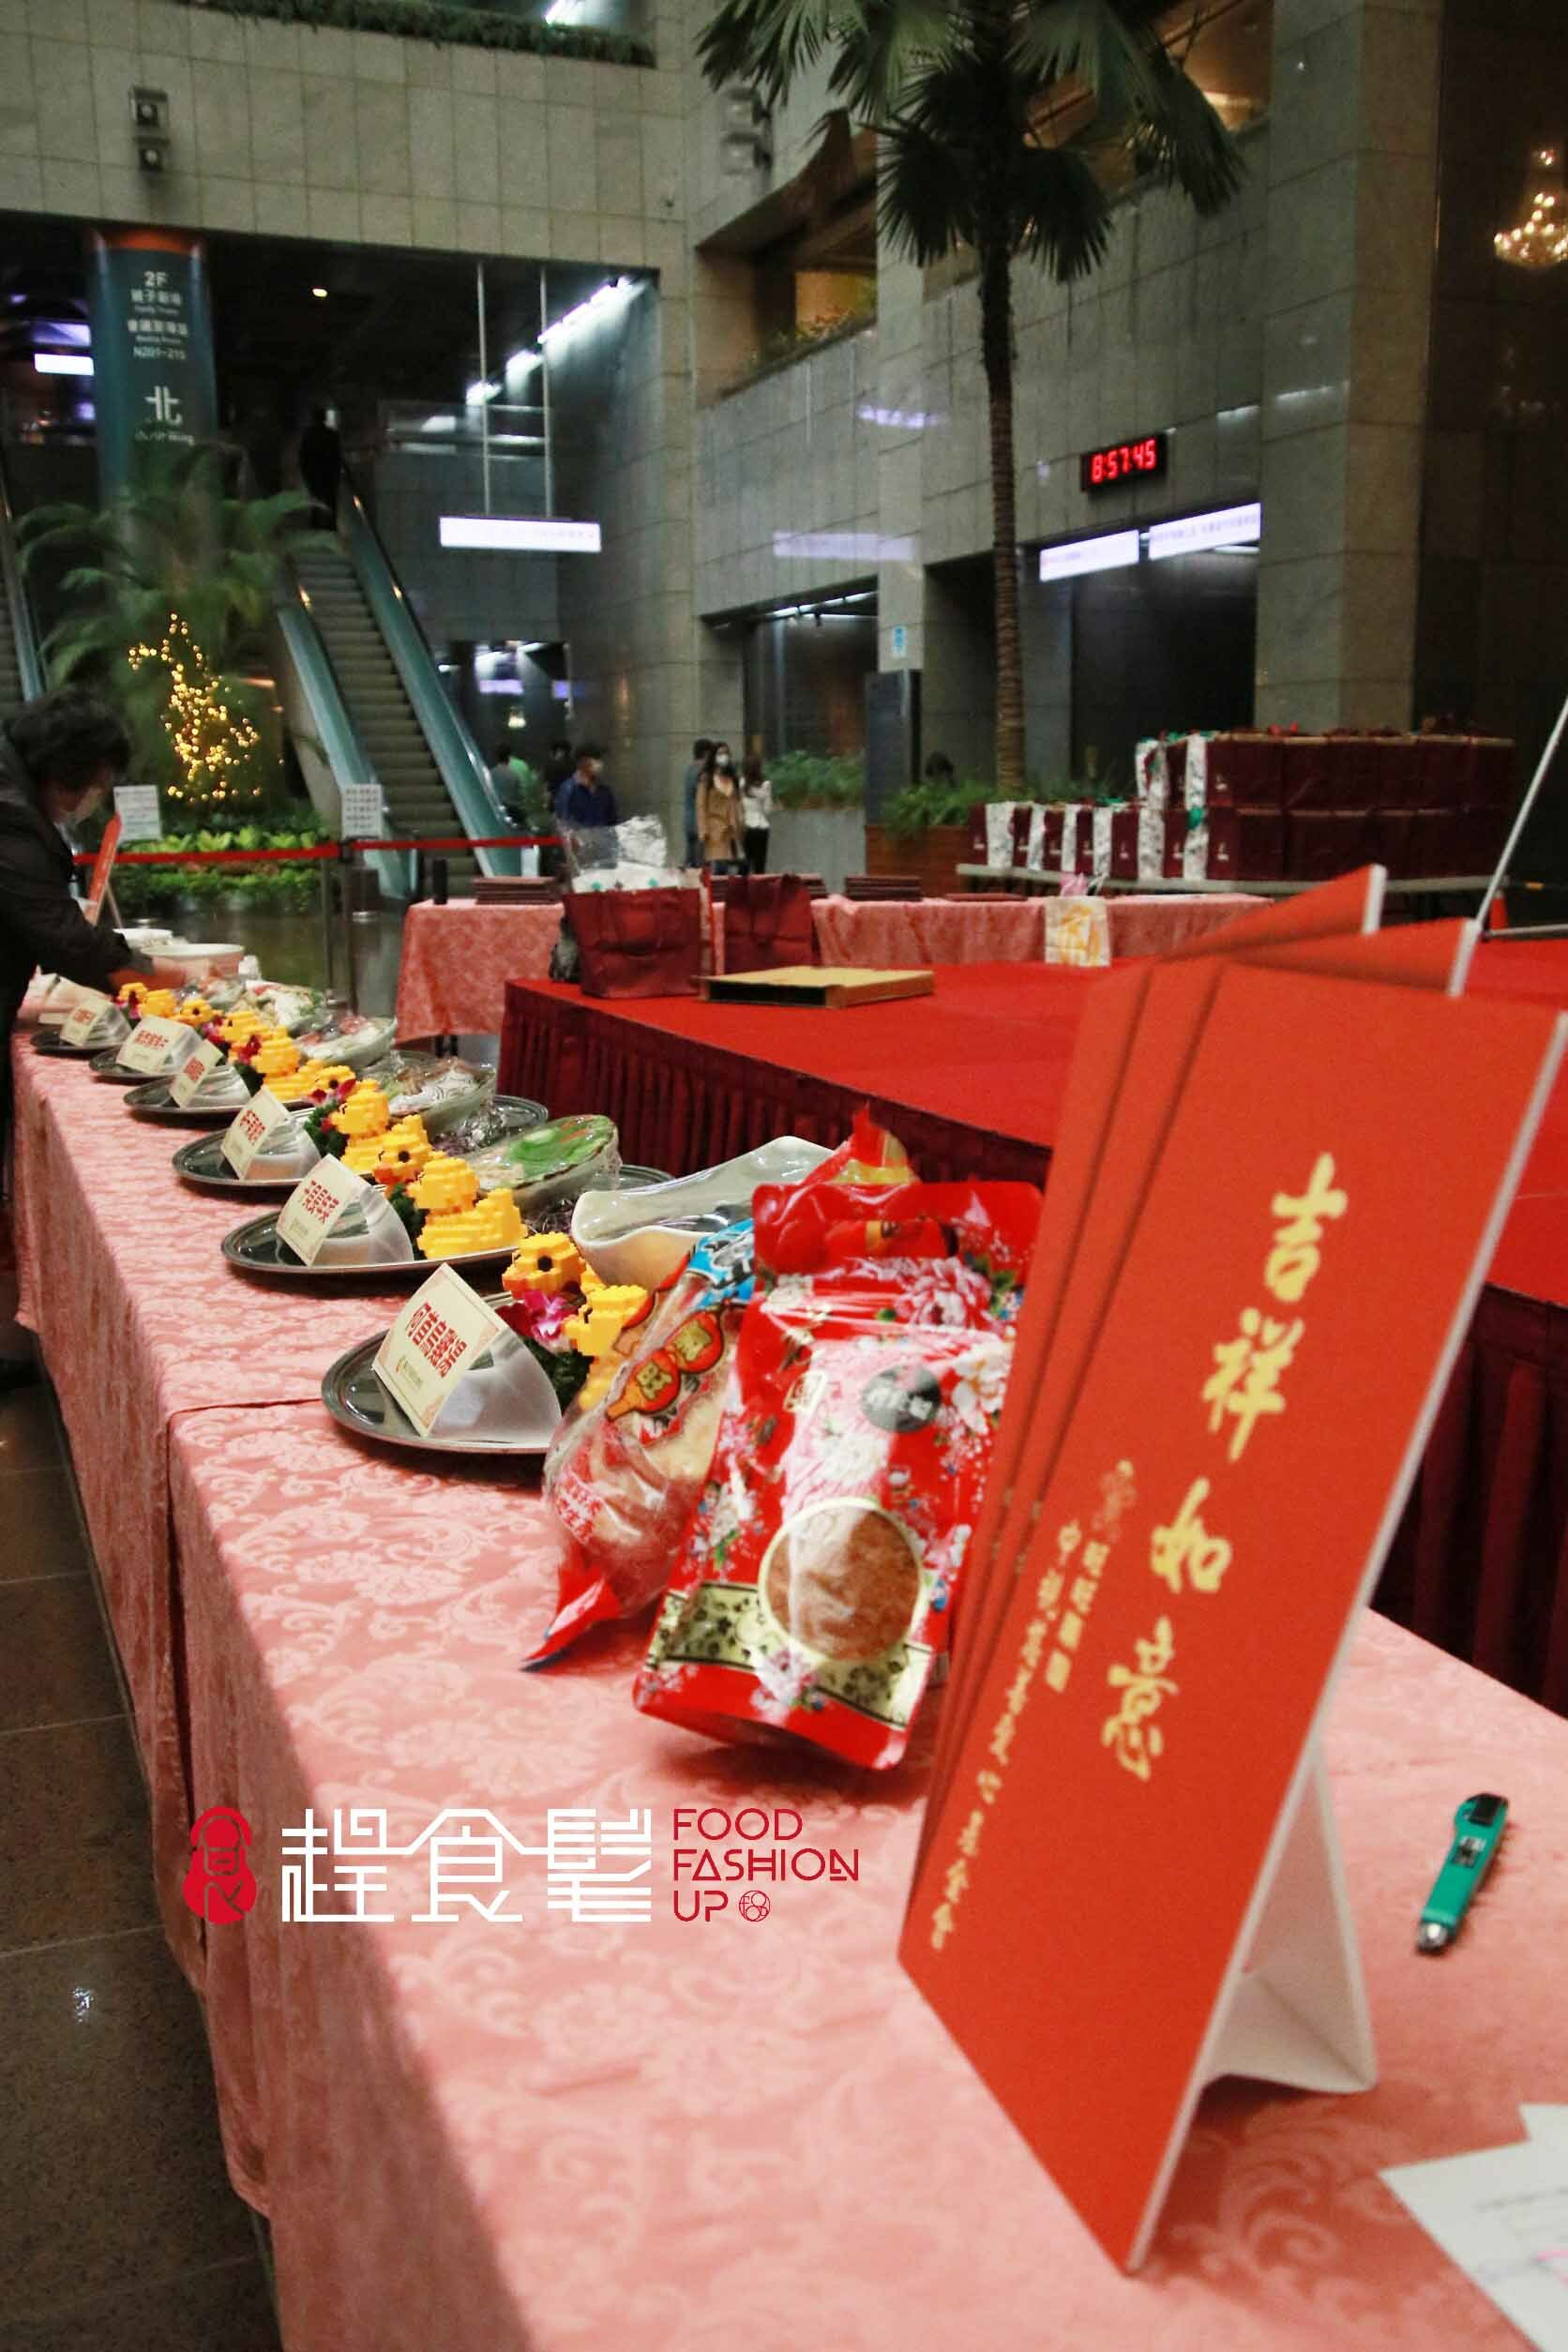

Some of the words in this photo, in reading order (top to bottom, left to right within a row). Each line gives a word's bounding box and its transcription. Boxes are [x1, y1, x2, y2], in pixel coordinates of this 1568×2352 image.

[143, 271, 167, 286] 2F
[143, 385, 183, 425] 北
[407, 1302, 467, 1379] 何首烏雞湯
[1102, 1152, 1349, 1783] 吉祥如意
